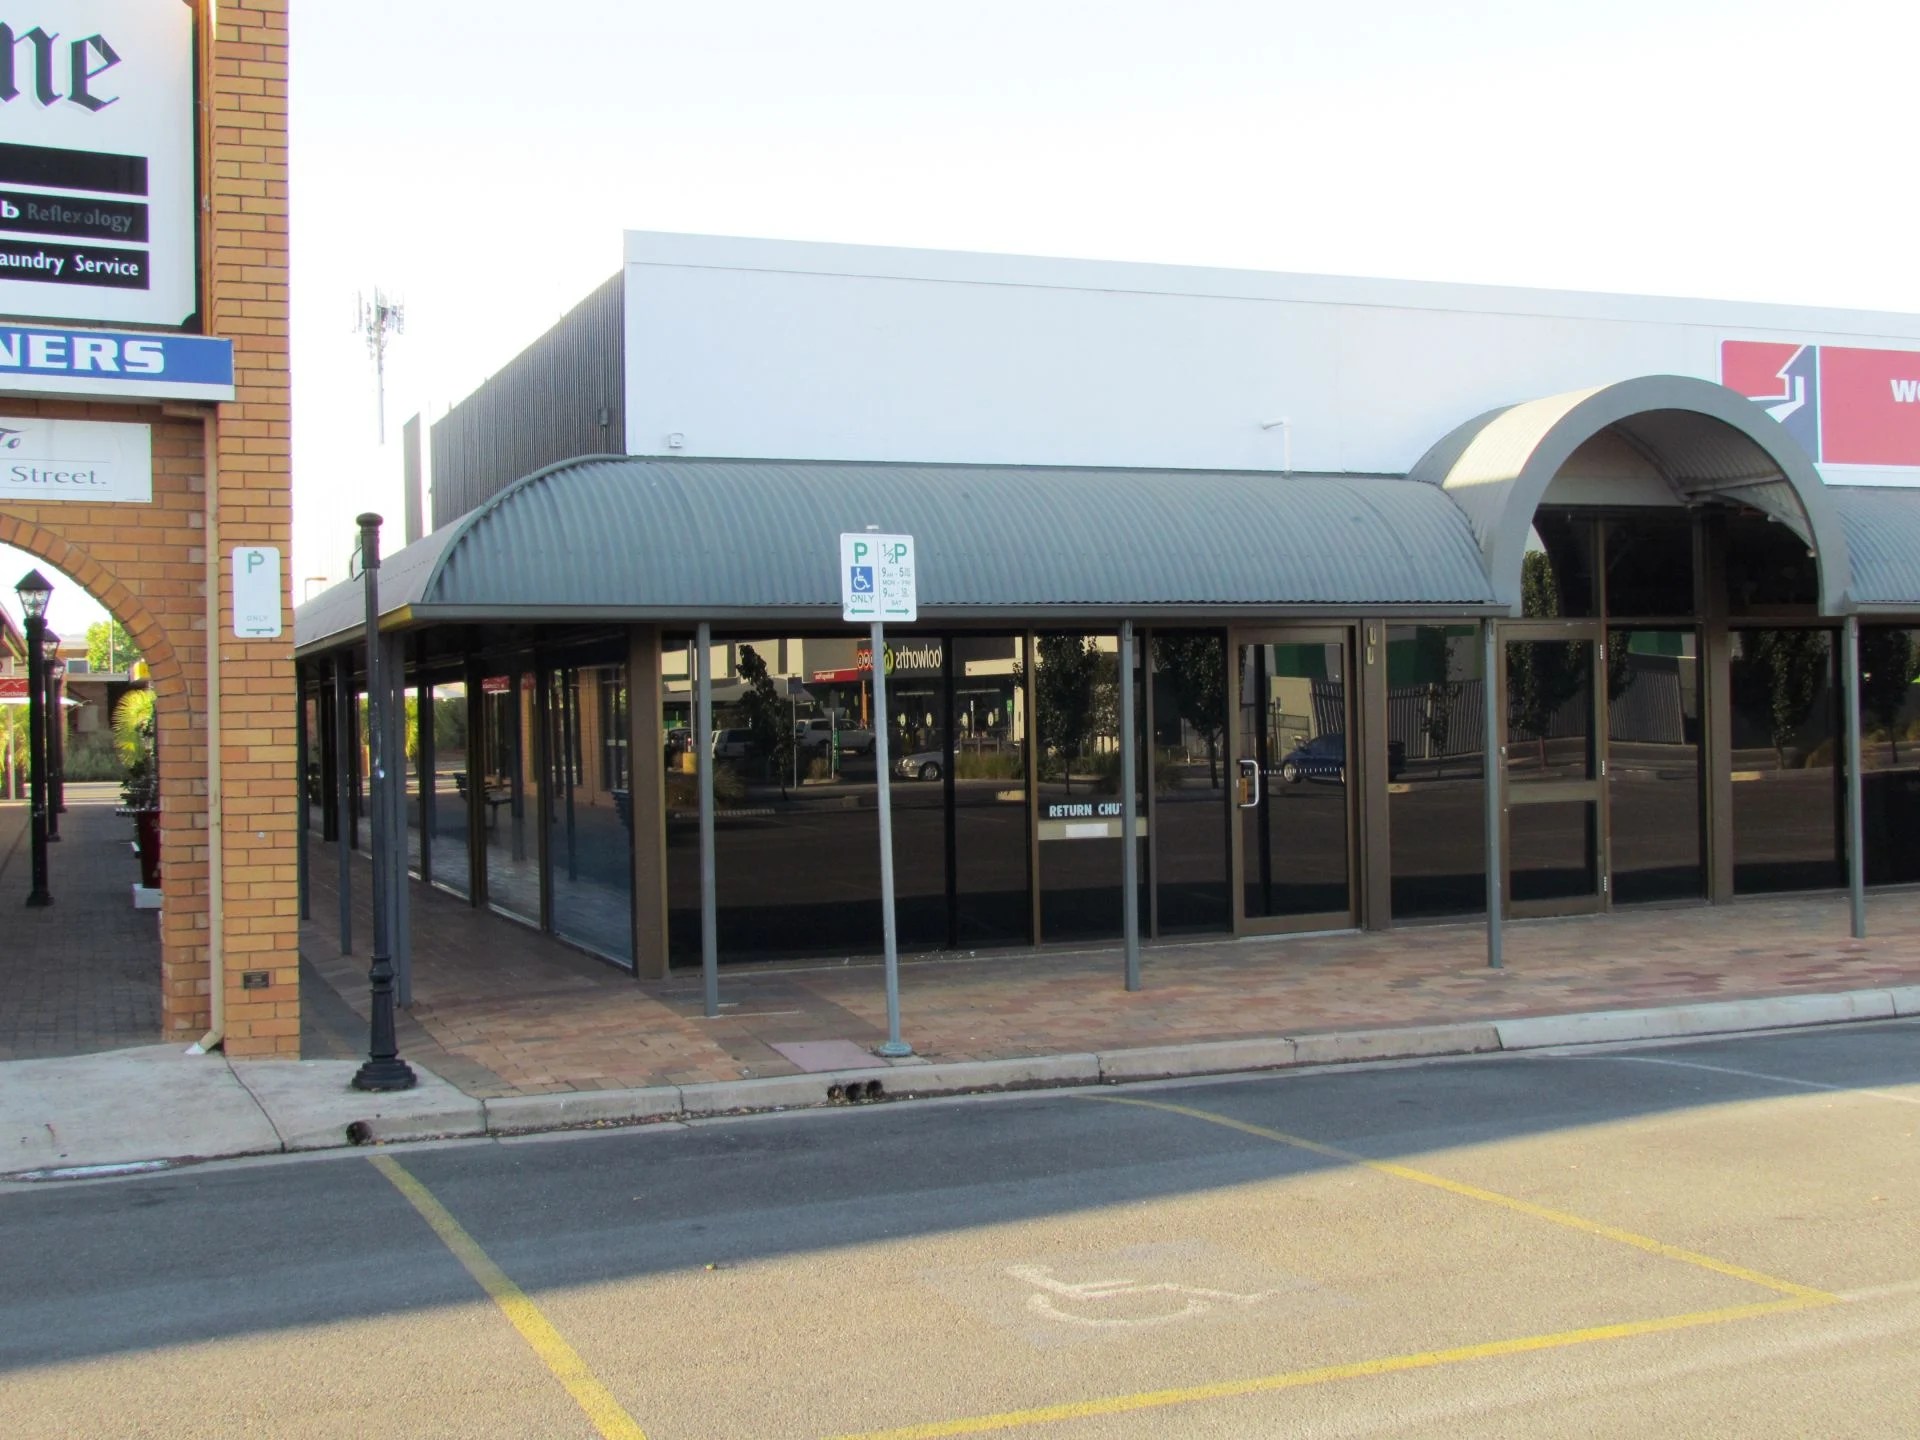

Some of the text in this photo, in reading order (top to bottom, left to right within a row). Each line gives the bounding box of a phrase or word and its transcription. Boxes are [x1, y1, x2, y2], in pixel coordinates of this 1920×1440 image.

[27, 202, 133, 233] Reflexology
[74, 254, 140, 276] Service
[1890, 379, 1920, 403] W
[248, 552, 265, 574] P
[854, 542, 868, 564] P
[850, 594, 875, 604] ONLY
[1049, 802, 1123, 817] RETURN CHU
